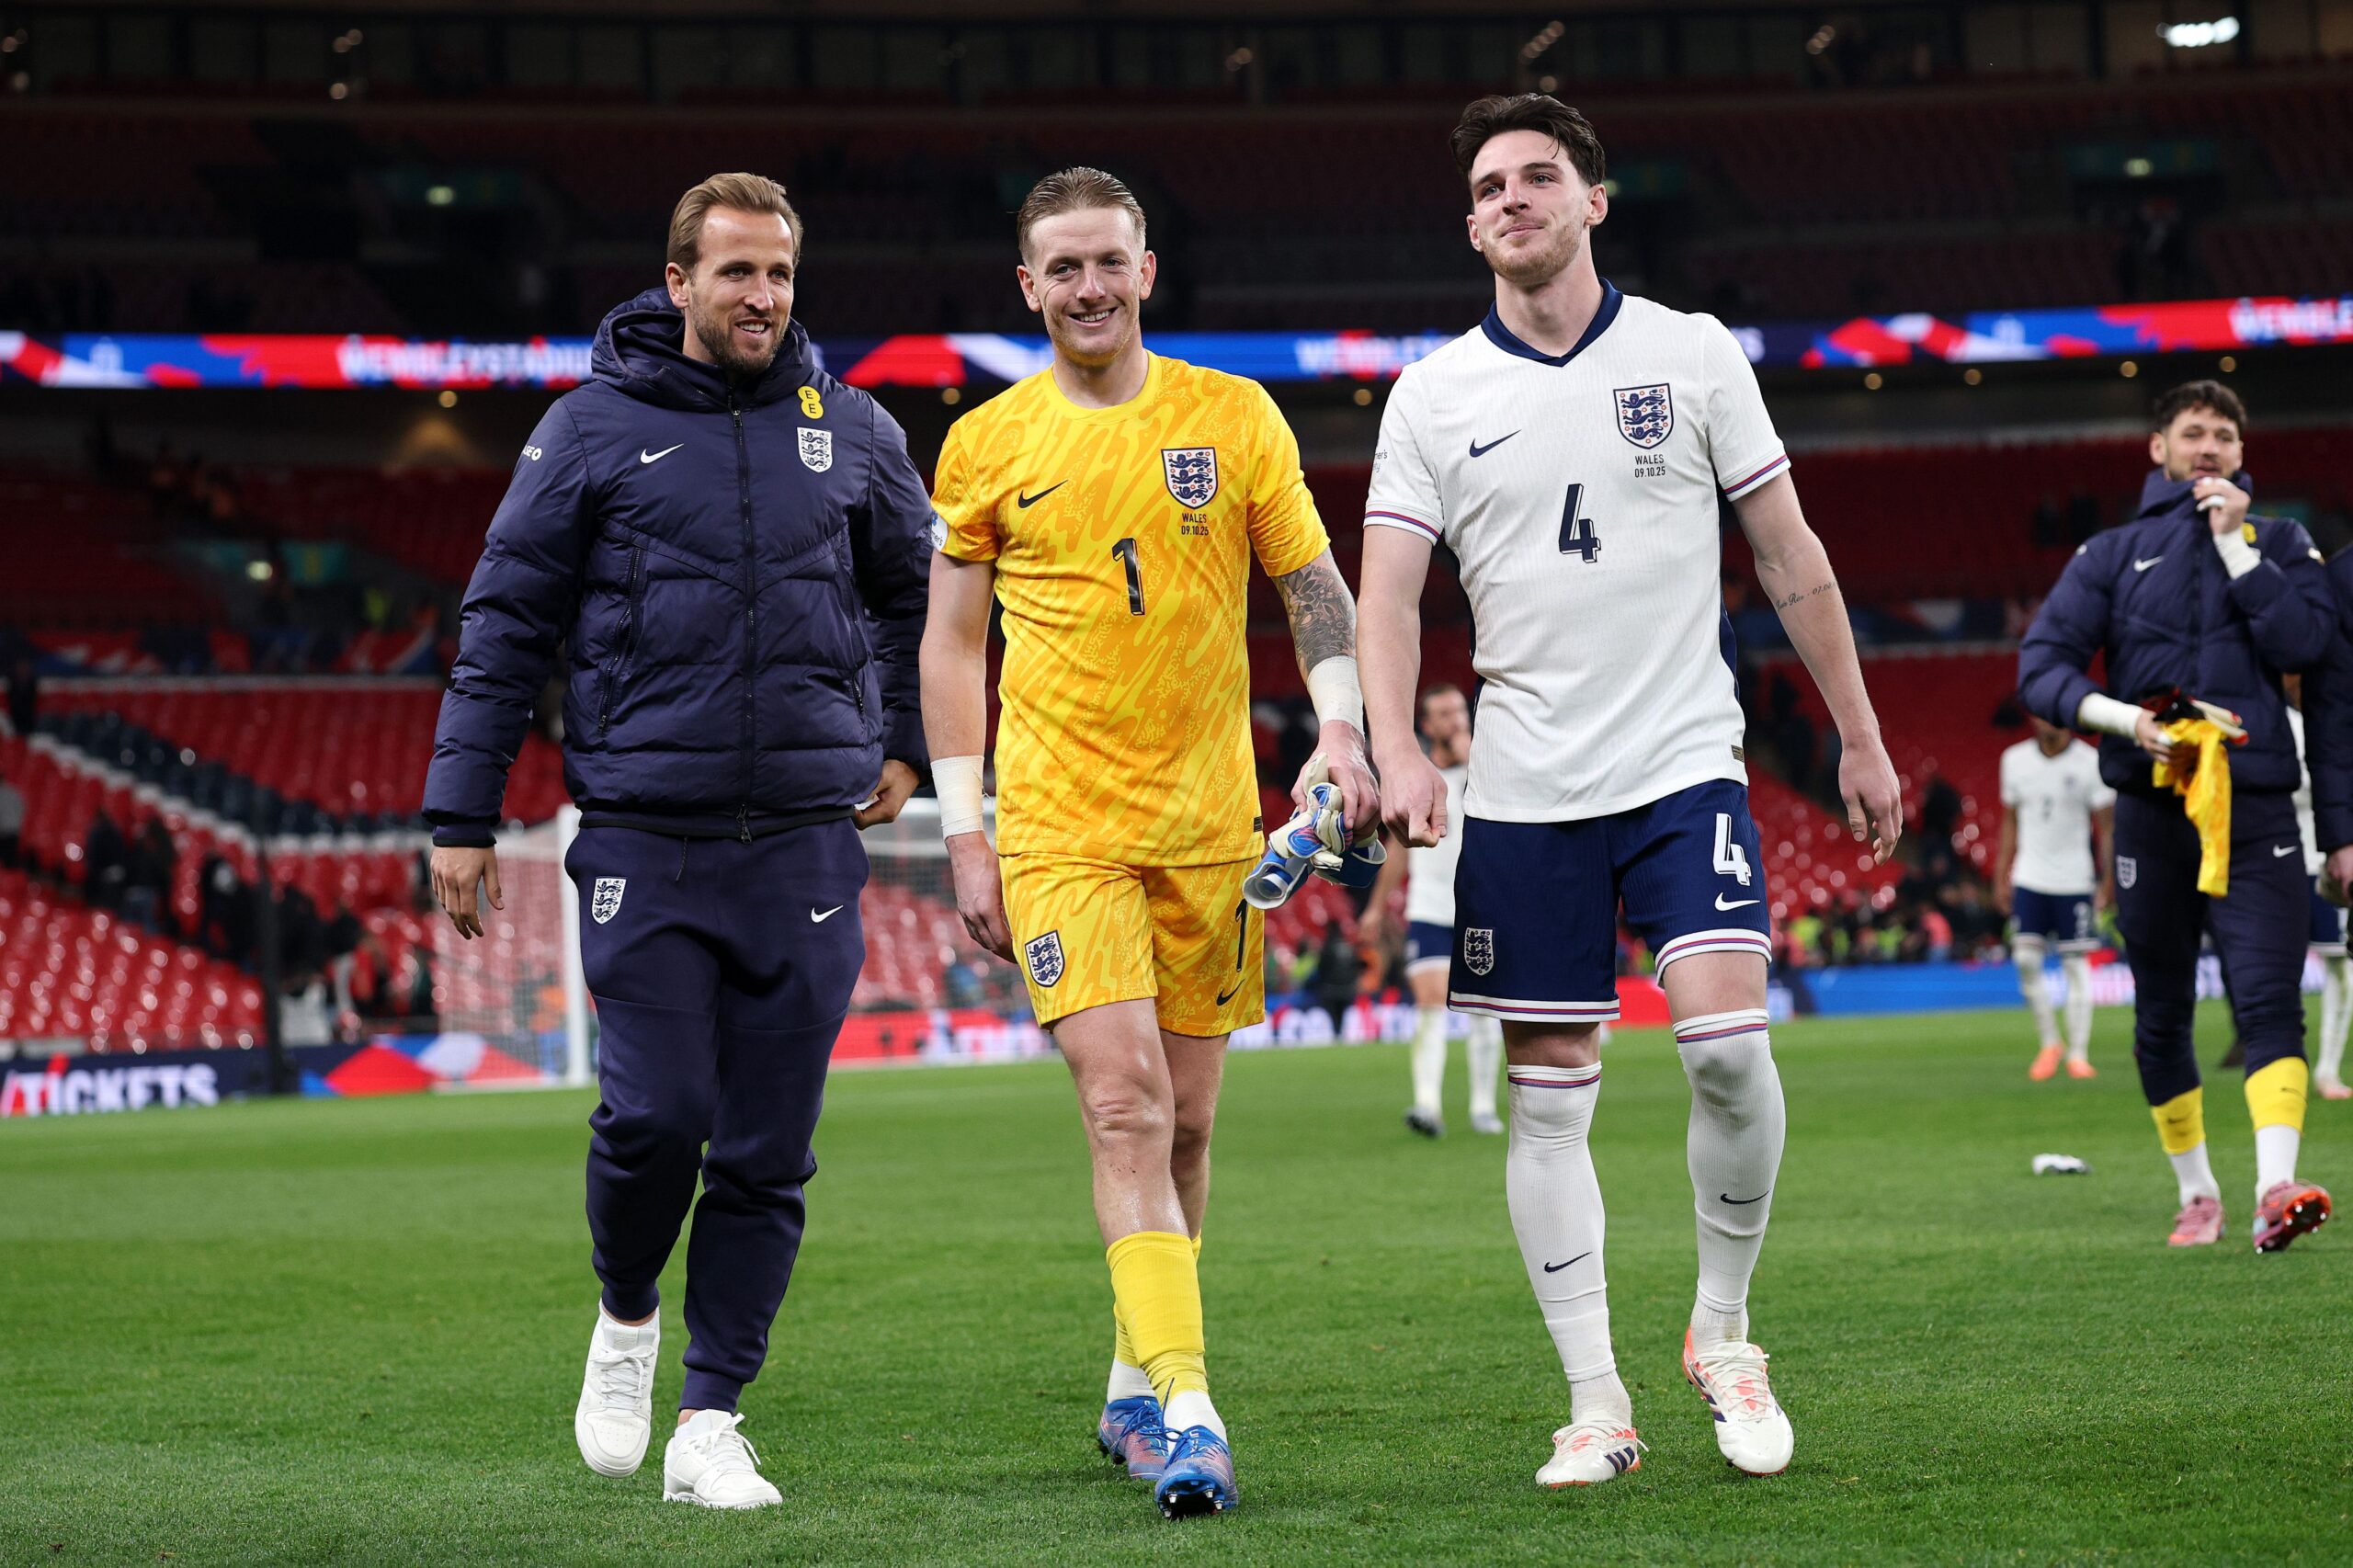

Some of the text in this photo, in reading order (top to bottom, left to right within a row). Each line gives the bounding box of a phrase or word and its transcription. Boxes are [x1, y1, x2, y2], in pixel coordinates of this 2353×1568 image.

[1634, 454, 1665, 465] WALES
[1634, 466, 1665, 478] 09.10.25
[1182, 513, 1207, 524] WALES
[1558, 483, 1601, 563] 4
[1181, 525, 1210, 536] 09.10.25
[1111, 537, 1145, 616] 1
[1712, 812, 1752, 887] 4
